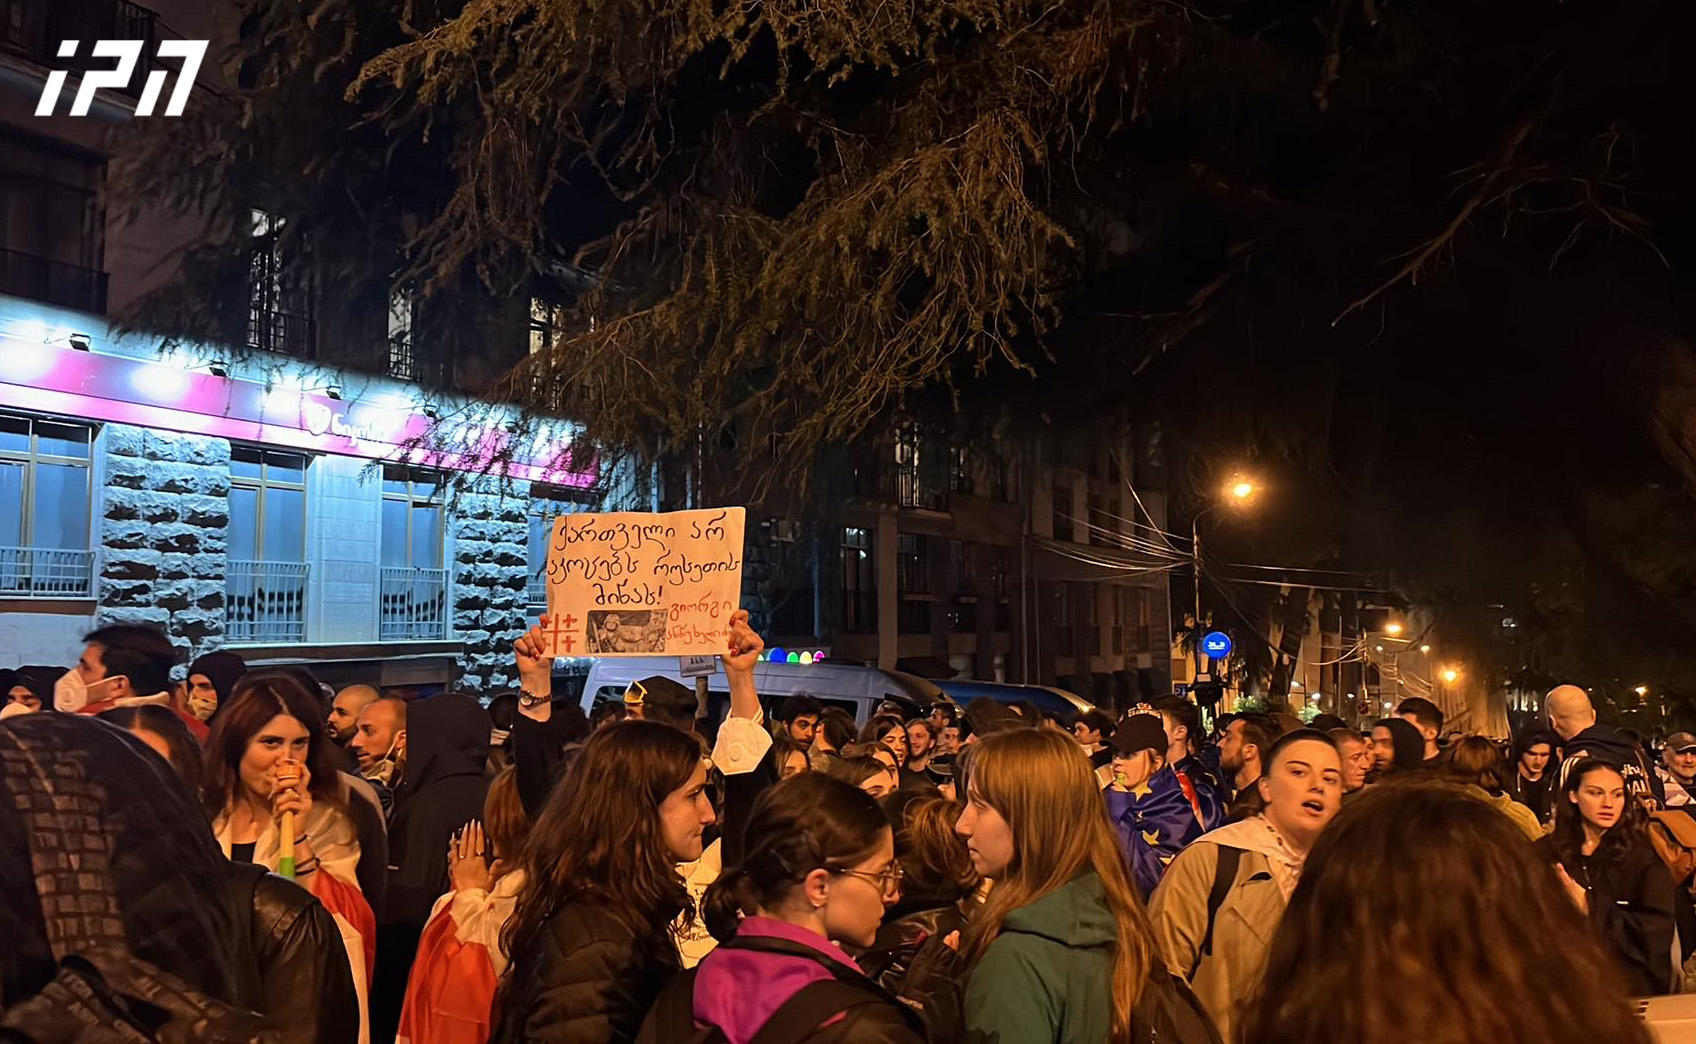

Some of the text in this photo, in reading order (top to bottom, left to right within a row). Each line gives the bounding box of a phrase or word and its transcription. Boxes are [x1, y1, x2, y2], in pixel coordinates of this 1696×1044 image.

[555, 511, 726, 551] ქართველი არ
[653, 549, 741, 586] რუსეთის
[592, 579, 663, 605] მიწას!
[670, 590, 732, 621] გიორგი
